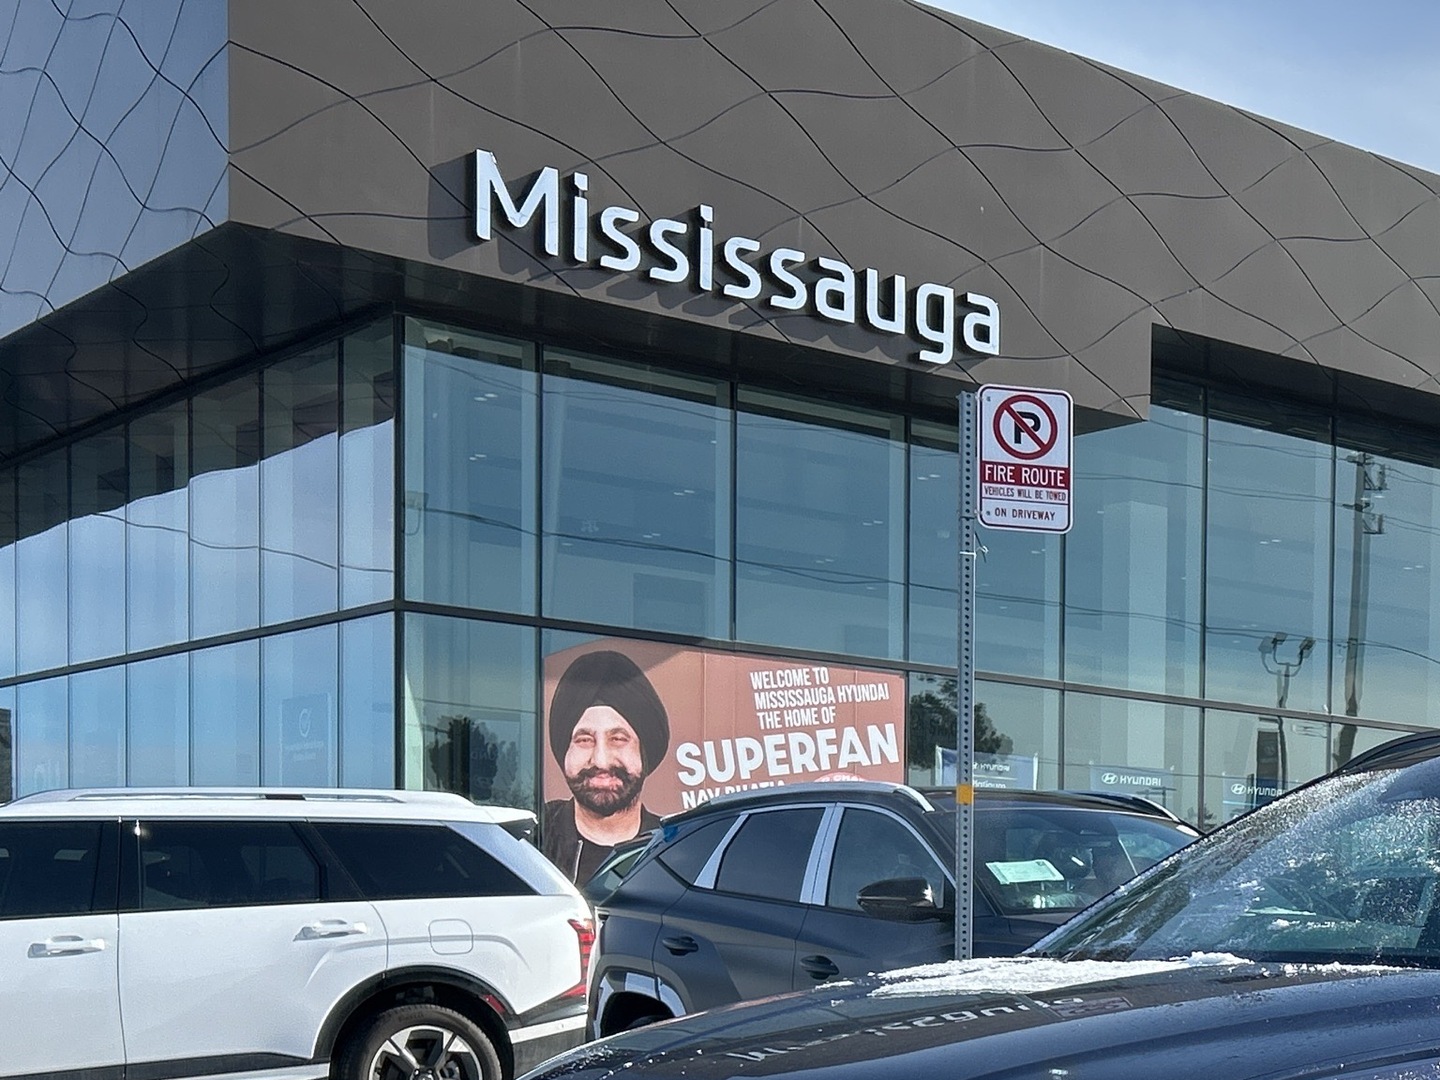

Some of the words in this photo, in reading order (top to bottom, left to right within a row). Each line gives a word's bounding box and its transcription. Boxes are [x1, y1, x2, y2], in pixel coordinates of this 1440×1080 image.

[475, 148, 1000, 365] Mississauga
[985, 464, 1015, 483] FIRE
[1021, 467, 1066, 487] ROUTE
[984, 486, 1015, 498] VEHICLES
[1017, 488, 1031, 499] WILL
[1034, 489, 1043, 500] BE
[1046, 490, 1067, 501] TOWED
[994, 507, 1007, 517] ON
[1012, 509, 1056, 521] DRIVEWAY
[750, 668, 812, 690] WELCOME
[812, 666, 830, 685] TO
[754, 686, 836, 710] MISSISSAUGA
[837, 682, 890, 703] HYUNDAI
[756, 711, 782, 730] THE
[784, 707, 820, 728] HOME
[821, 706, 837, 724] OF
[676, 723, 900, 787] SUPERFAN
[1119, 775, 1162, 787] HYUNDAI
